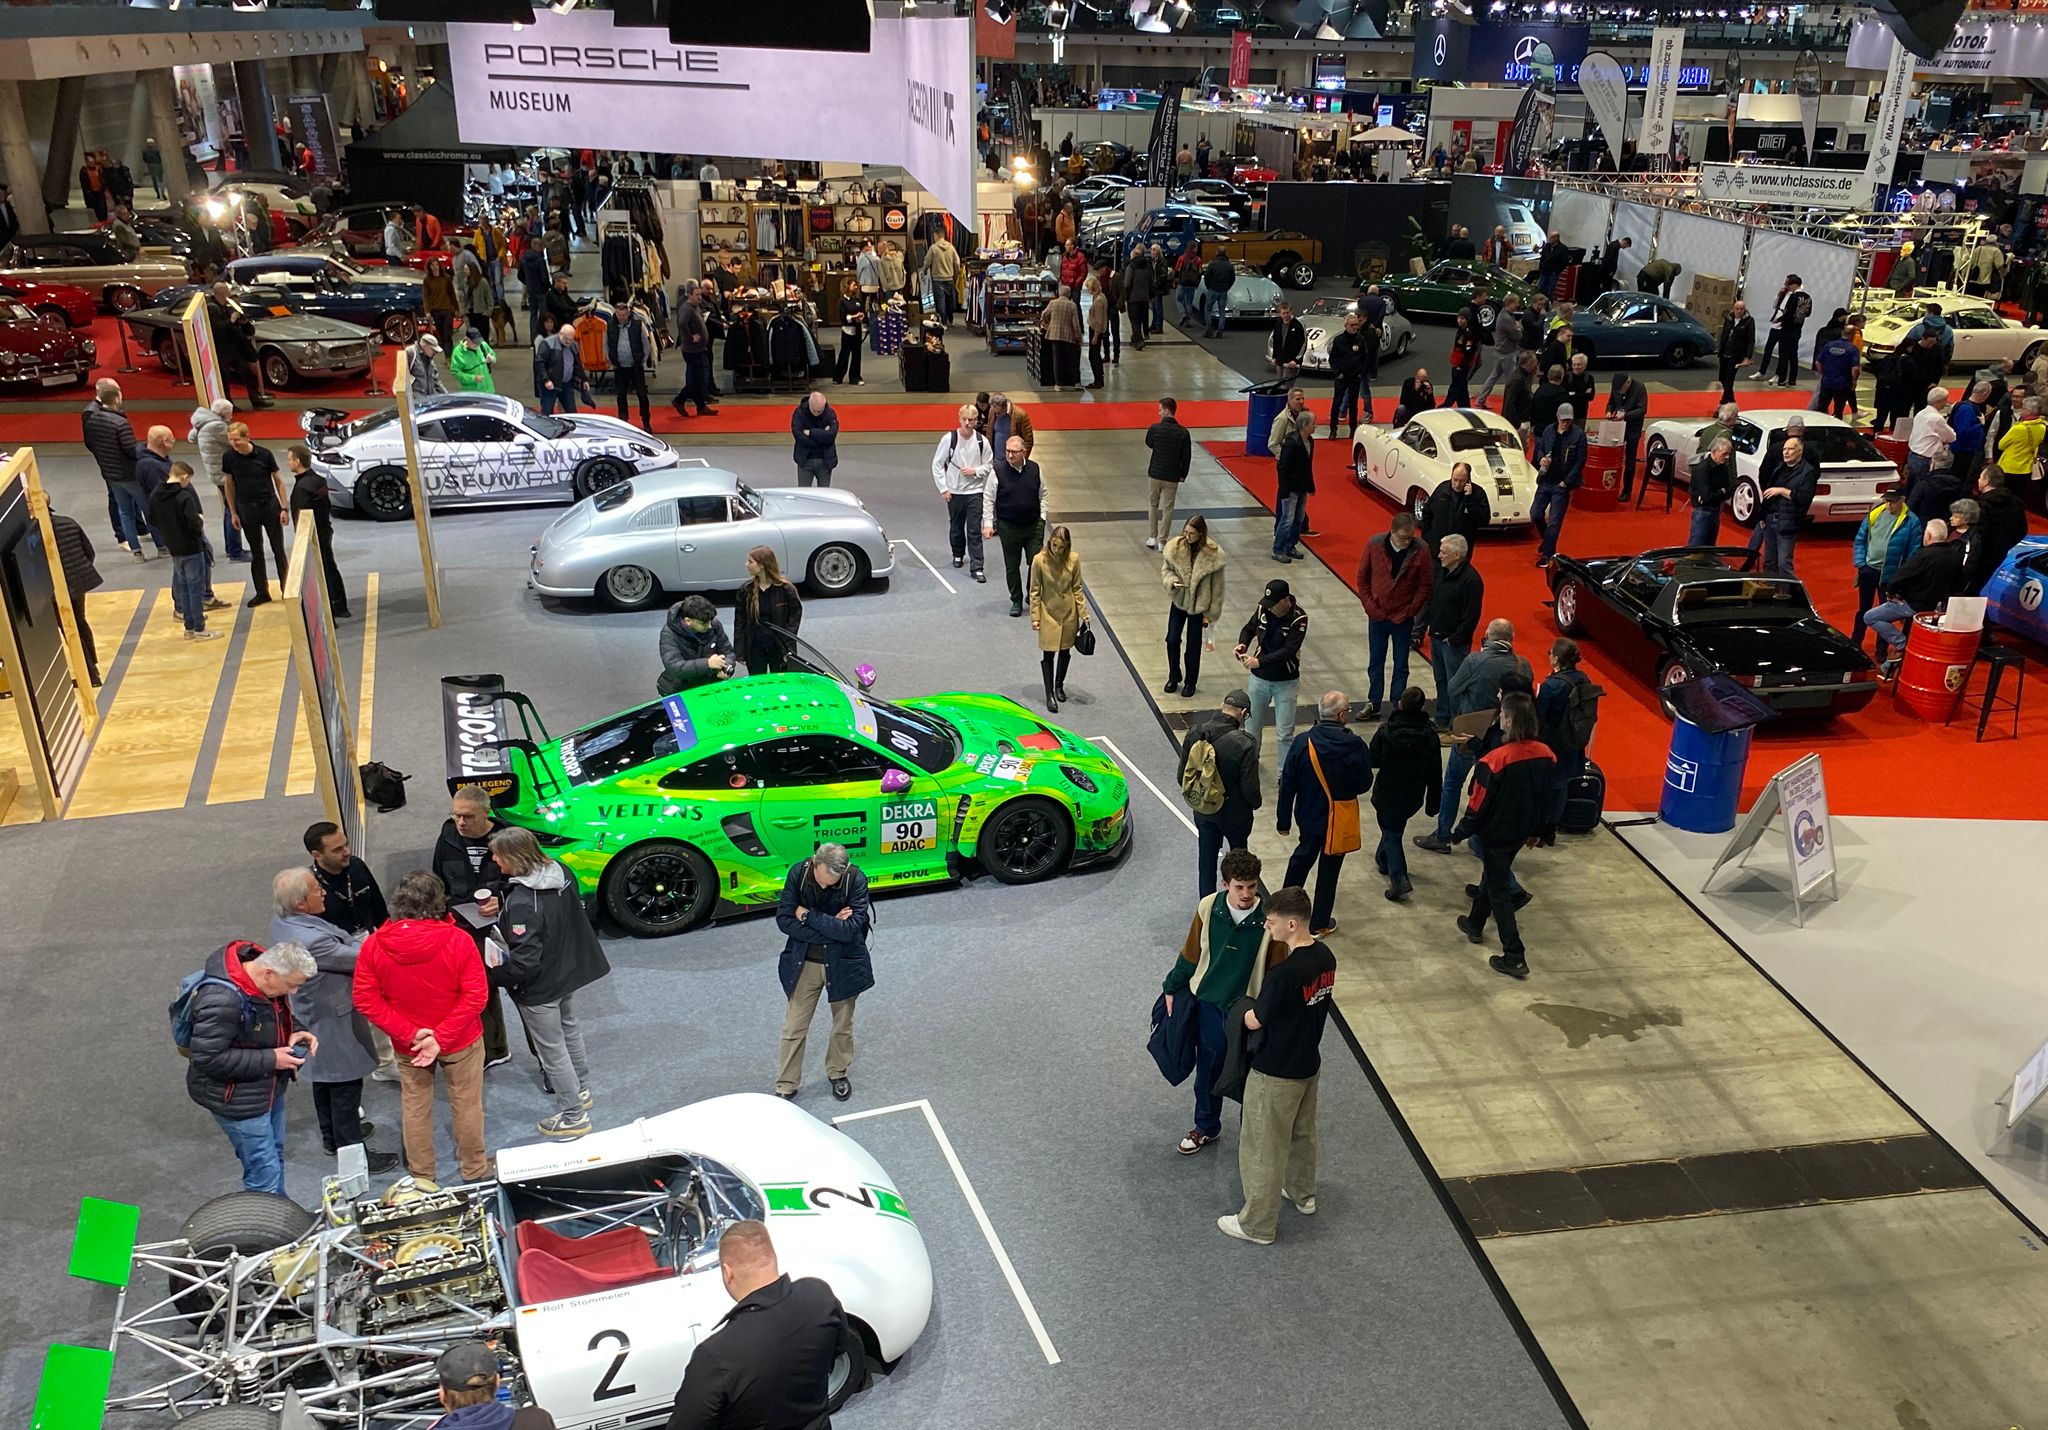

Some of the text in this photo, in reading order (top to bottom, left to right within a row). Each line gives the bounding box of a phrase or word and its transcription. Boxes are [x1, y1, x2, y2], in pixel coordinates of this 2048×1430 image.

[484, 44, 719, 72] PORSCHE
[1943, 59, 1991, 70] AUTOMOBILE
[489, 90, 571, 112] MUSEUM
[382, 151, 482, 161] www.classicchrome.eu
[1751, 174, 1853, 190] www.vhclassics.de
[1748, 189, 1851, 201] klassisches Rallye Zubehör
[886, 216, 904, 224] Gulf
[424, 472, 520, 493] USEUM
[2023, 585, 2041, 605] 17
[456, 692, 502, 777] TRICORP
[890, 729, 919, 758] 90
[560, 738, 582, 777] TRICORP
[477, 779, 513, 788] LEGEND
[597, 803, 704, 821] VELTINS
[881, 802, 936, 821] DEKRA
[814, 826, 868, 838] TRICORP
[896, 821, 923, 840] 90
[891, 838, 926, 853] ADAC
[892, 869, 929, 881] MOTUL
[809, 1186, 874, 1211] 2
[542, 1290, 631, 1313] Rolf Stommelen
[587, 1328, 637, 1402] 2
